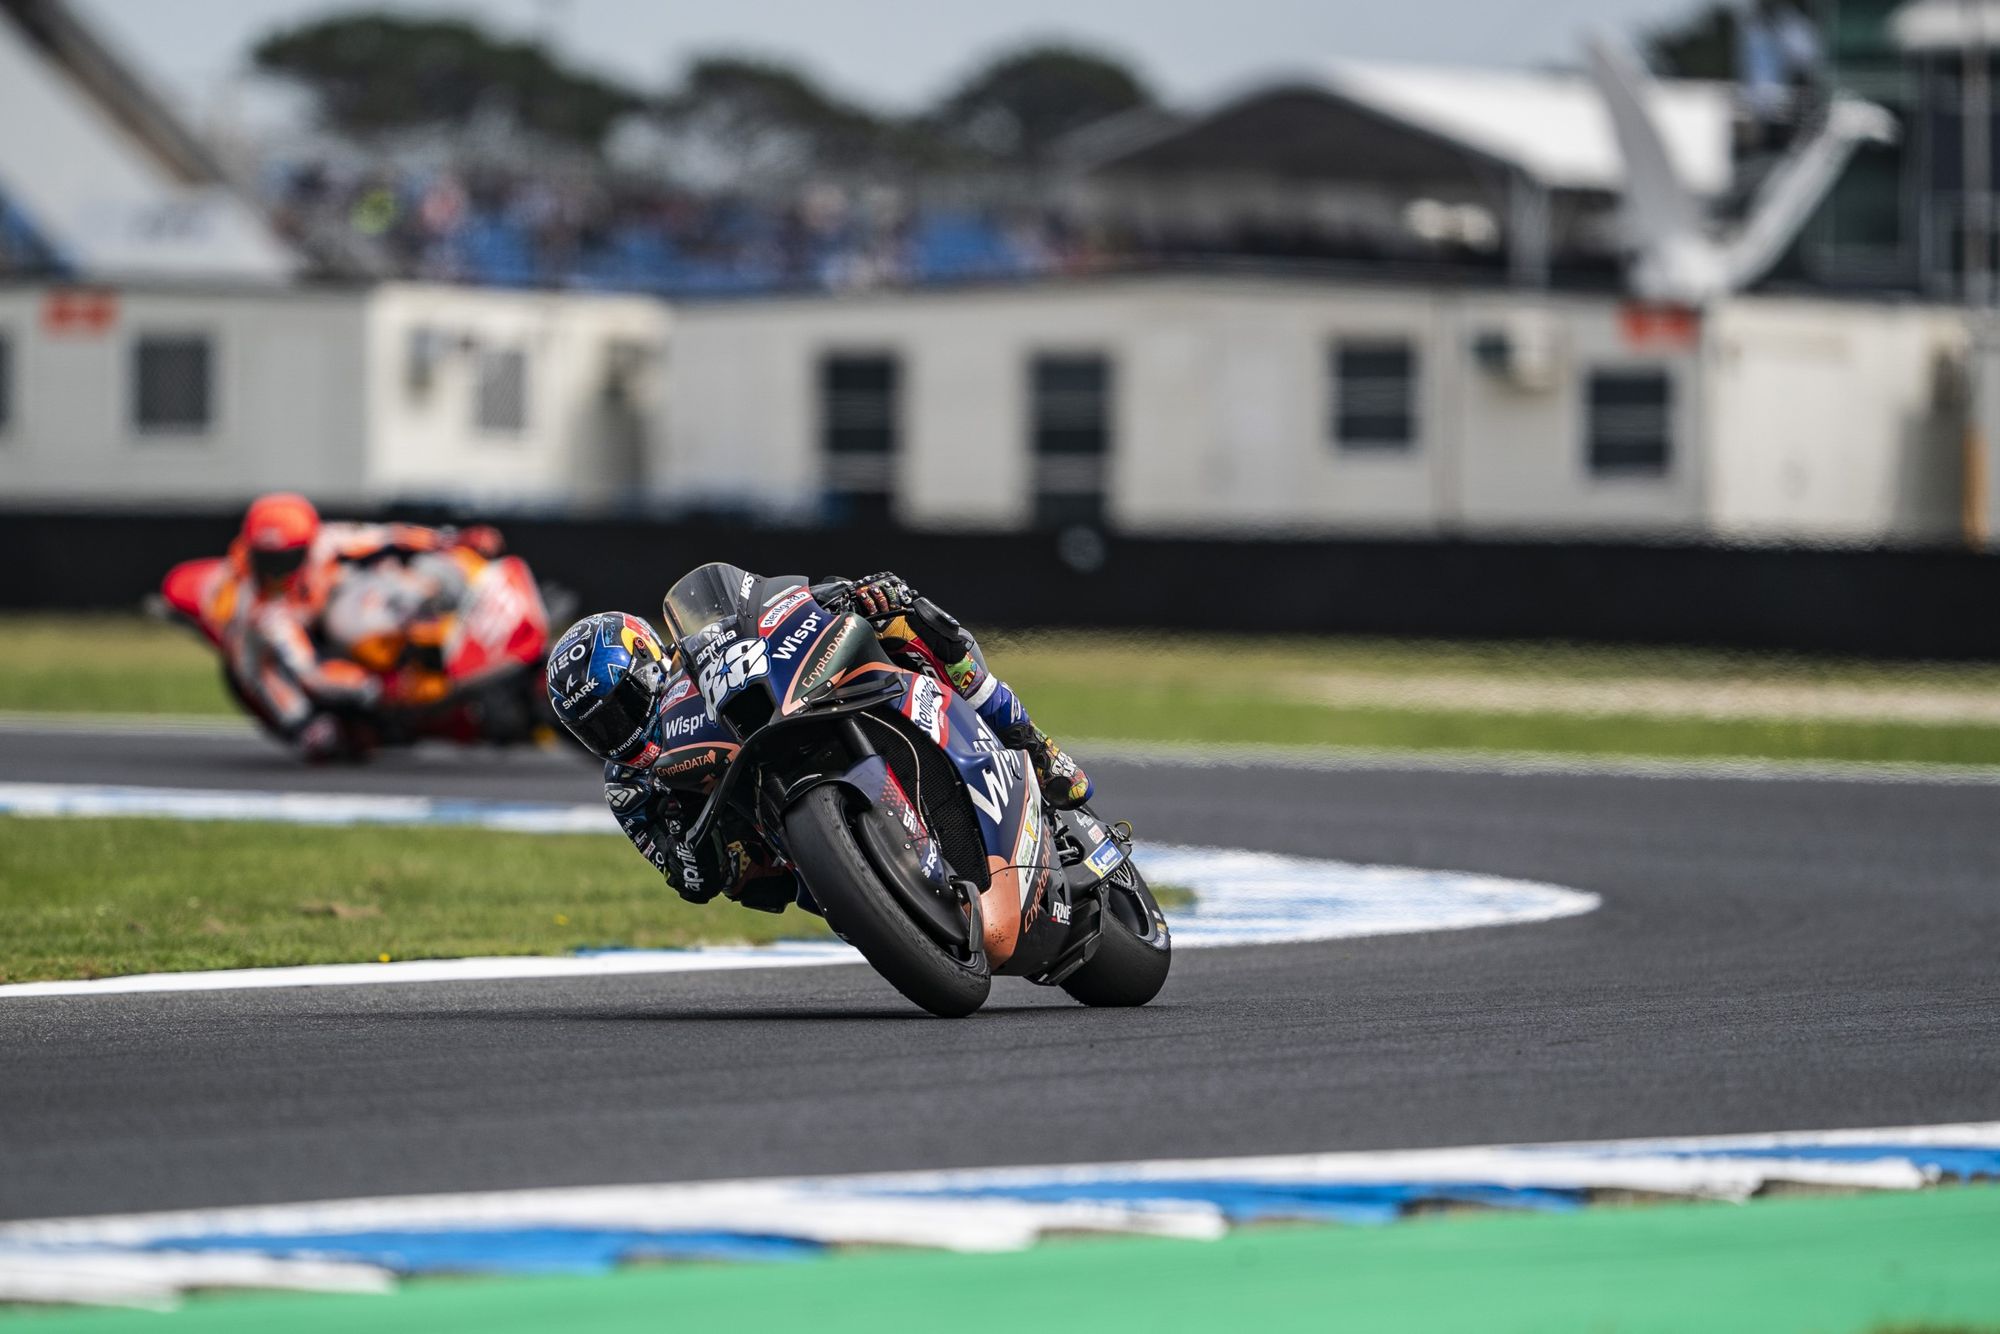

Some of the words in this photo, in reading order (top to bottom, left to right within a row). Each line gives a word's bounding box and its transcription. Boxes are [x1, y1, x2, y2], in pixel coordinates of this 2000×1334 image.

[696, 630, 737, 665] aprilia
[772, 611, 822, 660] Wispr
[562, 678, 600, 710] SHARK
[666, 712, 706, 739] Wispr
[634, 745, 661, 770] prilia
[656, 750, 715, 778] CryptoDATA
[676, 841, 704, 891] aprili
